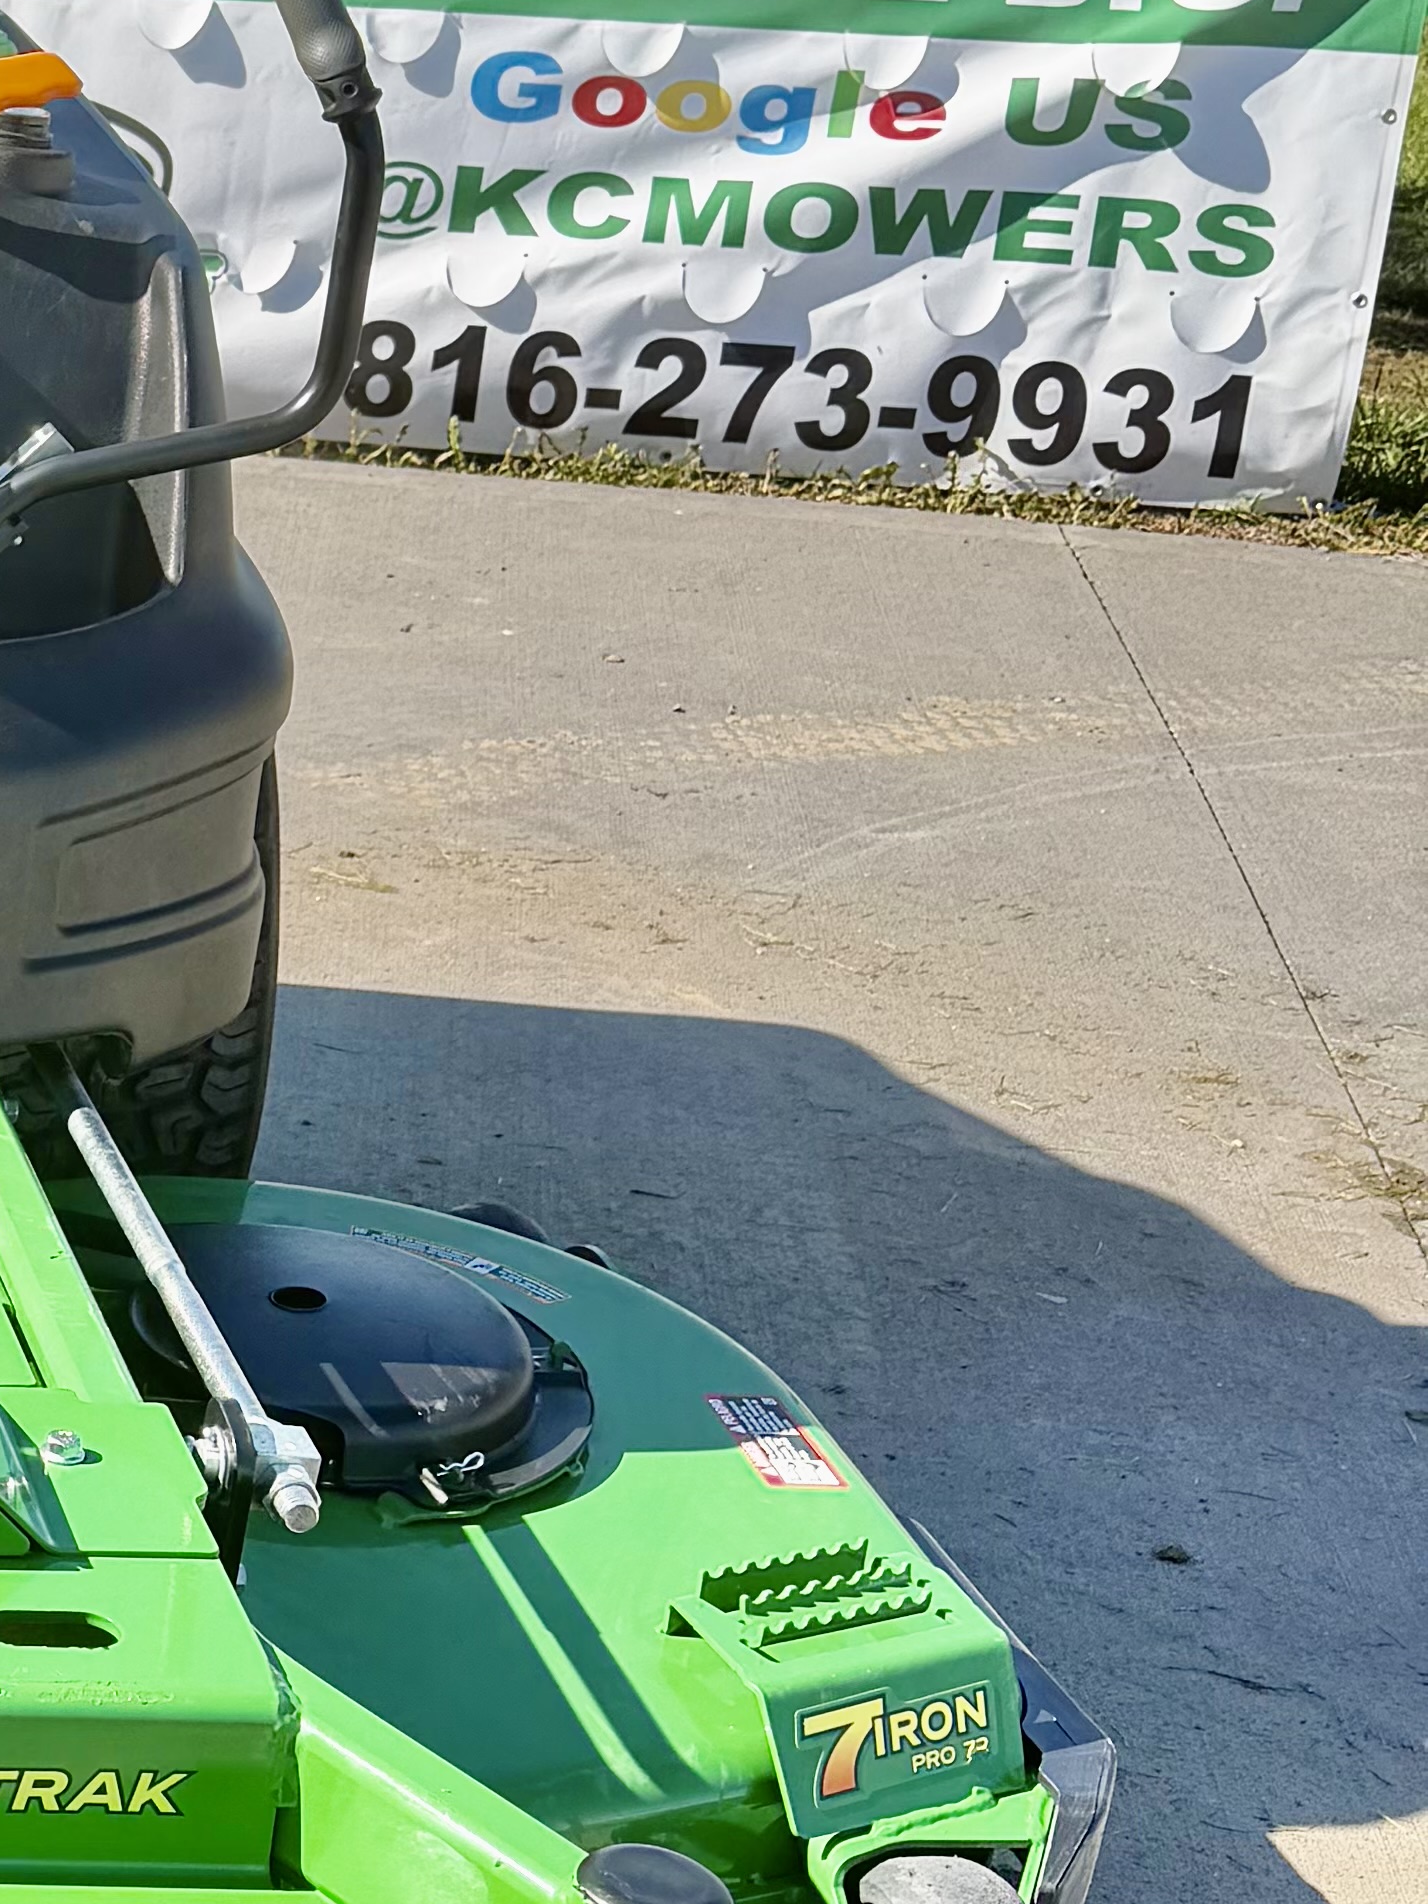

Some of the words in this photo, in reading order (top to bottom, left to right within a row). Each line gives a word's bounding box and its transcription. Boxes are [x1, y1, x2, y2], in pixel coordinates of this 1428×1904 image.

[471, 51, 946, 155] Google
[1005, 77, 1193, 151] US
[377, 161, 1276, 278] @KCMOWERS
[345, 320, 1253, 479] 816-273-9931
[911, 1746, 956, 1773] PRO
